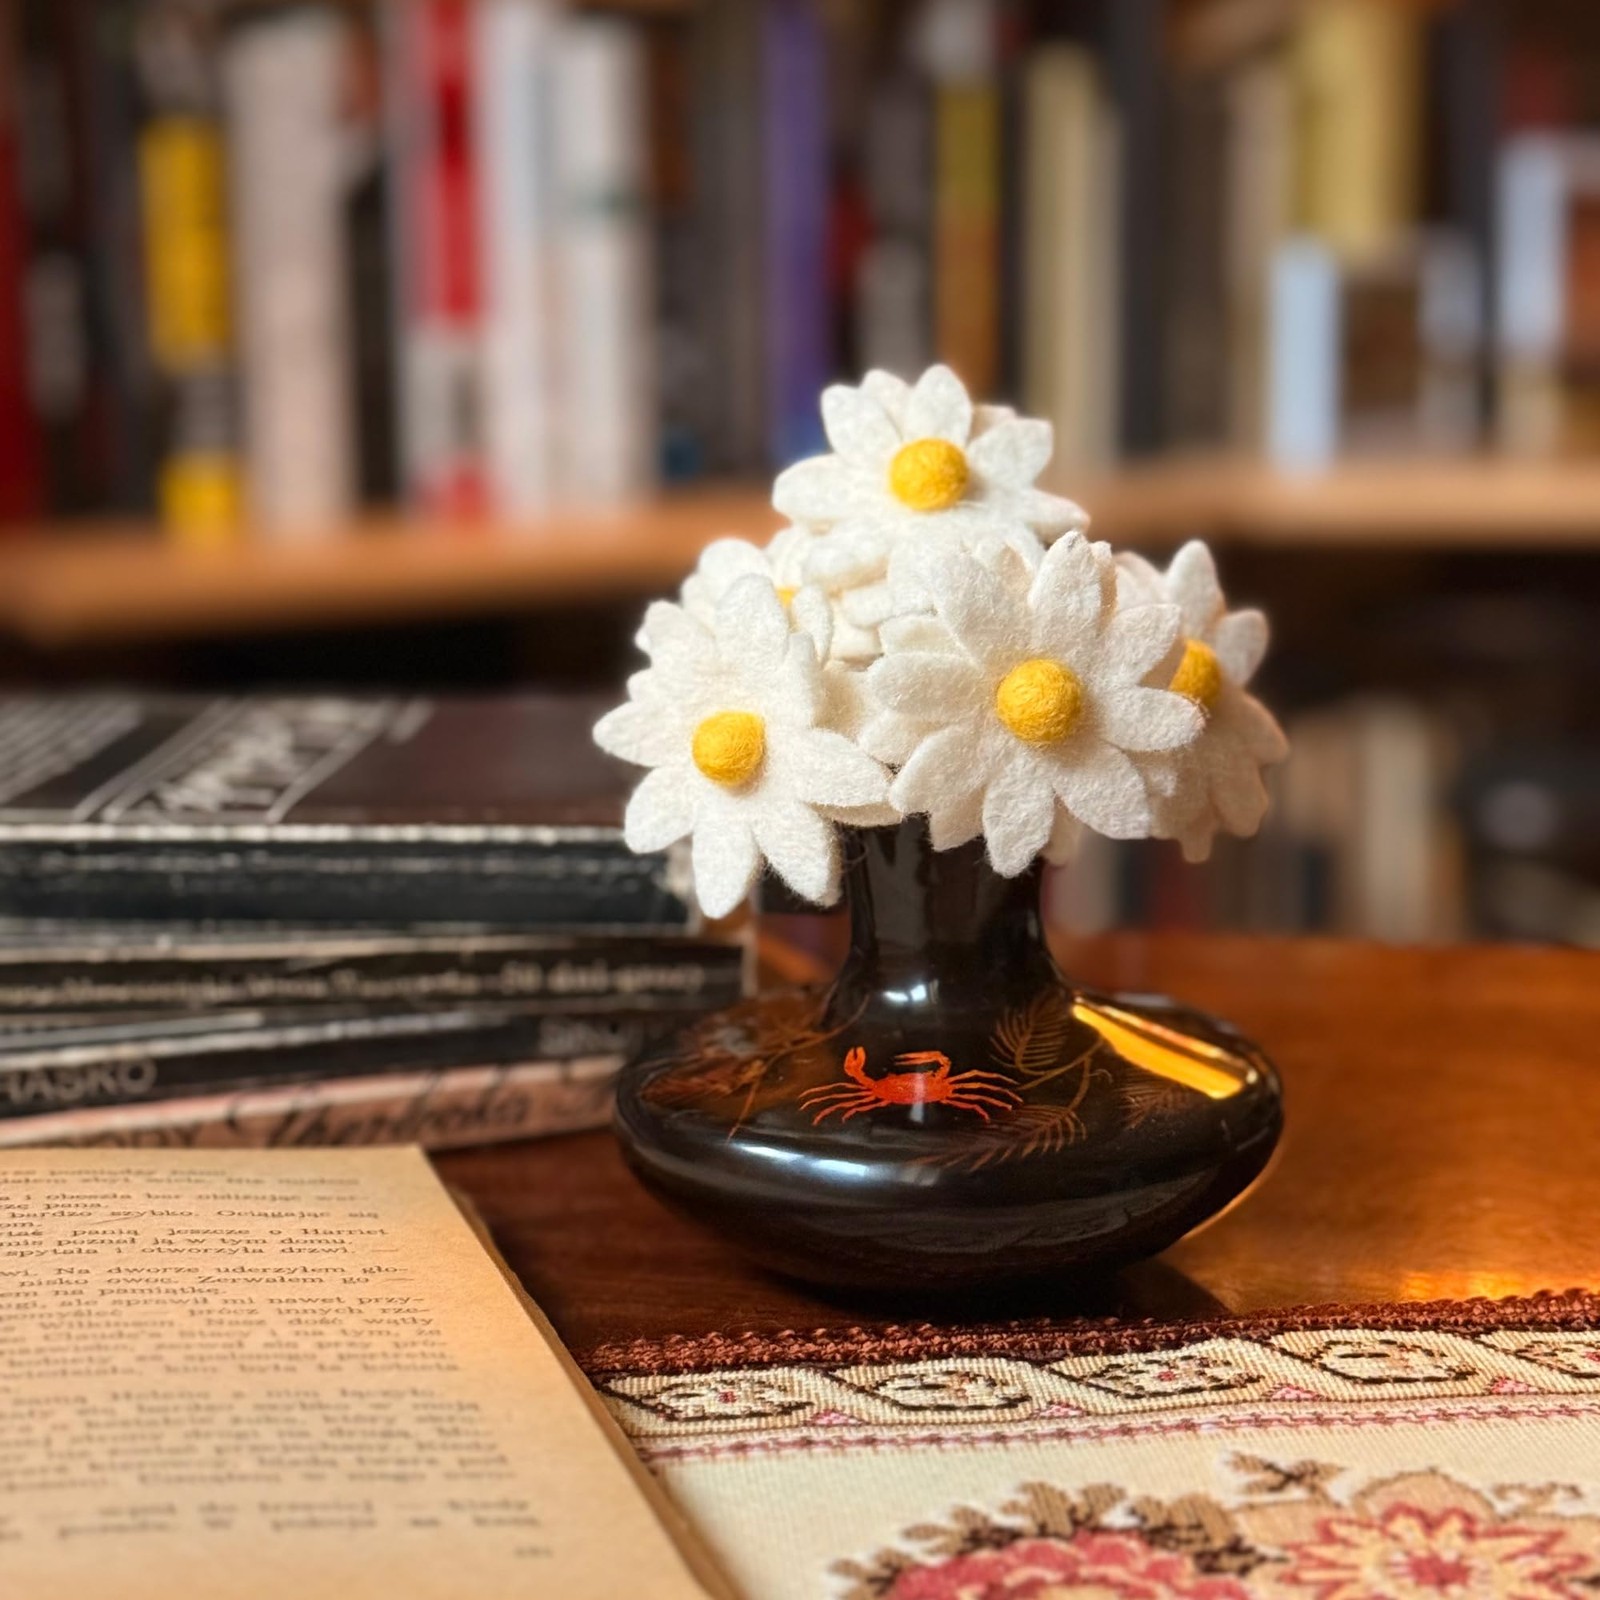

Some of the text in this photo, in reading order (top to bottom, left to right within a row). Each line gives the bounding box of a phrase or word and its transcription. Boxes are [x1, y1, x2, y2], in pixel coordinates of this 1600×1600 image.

[8, 1209, 92, 1218] bardzo
[108, 1210, 199, 1219] szybko.
[70, 1229, 140, 1237] panią
[56, 1236, 136, 1246] poznał
[4, 1248, 99, 1257] spytała
[215, 1266, 345, 1274] uderzyłem
[18, 1278, 88, 1287] nisko
[98, 1287, 226, 1296] pamiątkę.
[59, 1299, 98, 1307] ale
[111, 1297, 209, 1306] sprawił
[187, 1308, 259, 1317] prócz
[275, 1307, 364, 1315] innych
